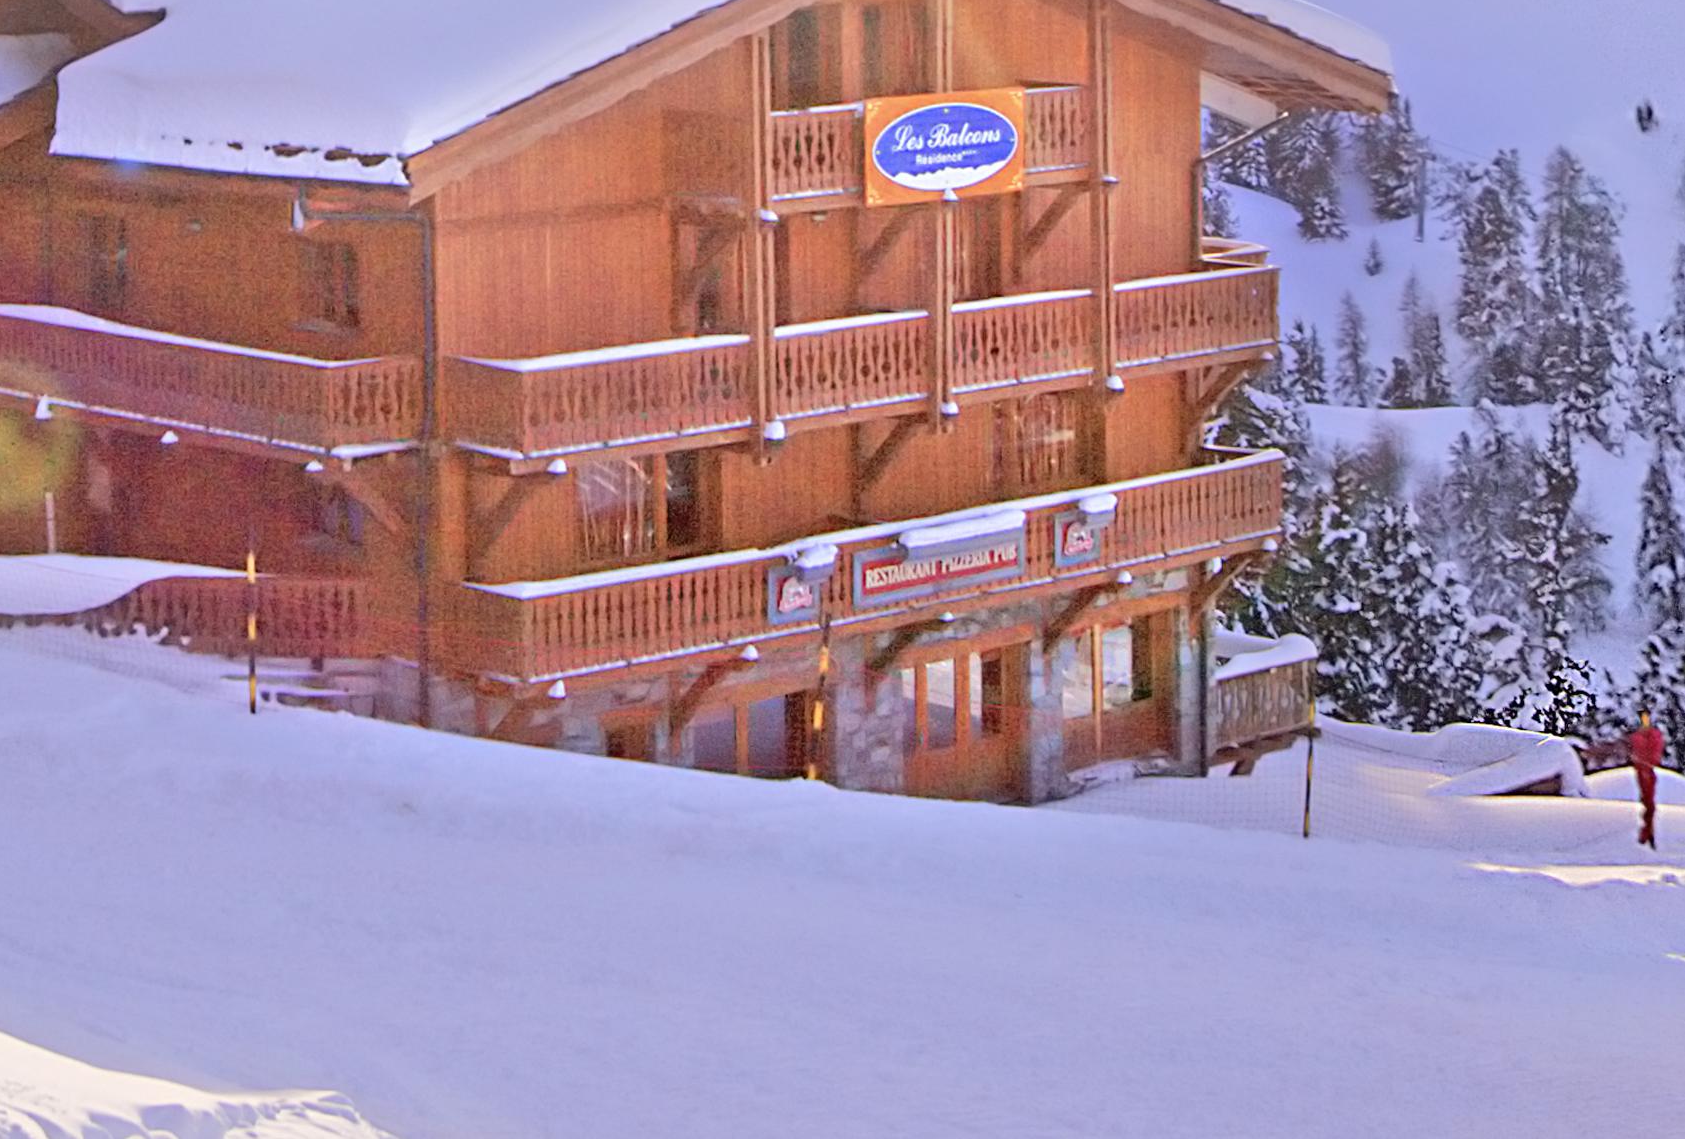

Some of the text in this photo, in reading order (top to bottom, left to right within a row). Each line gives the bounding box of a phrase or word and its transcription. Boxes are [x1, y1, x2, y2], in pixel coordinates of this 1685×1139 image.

[891, 122, 1001, 151] Les Balcons
[865, 541, 1018, 589] RESTAURANT PIZZERIA PUB
